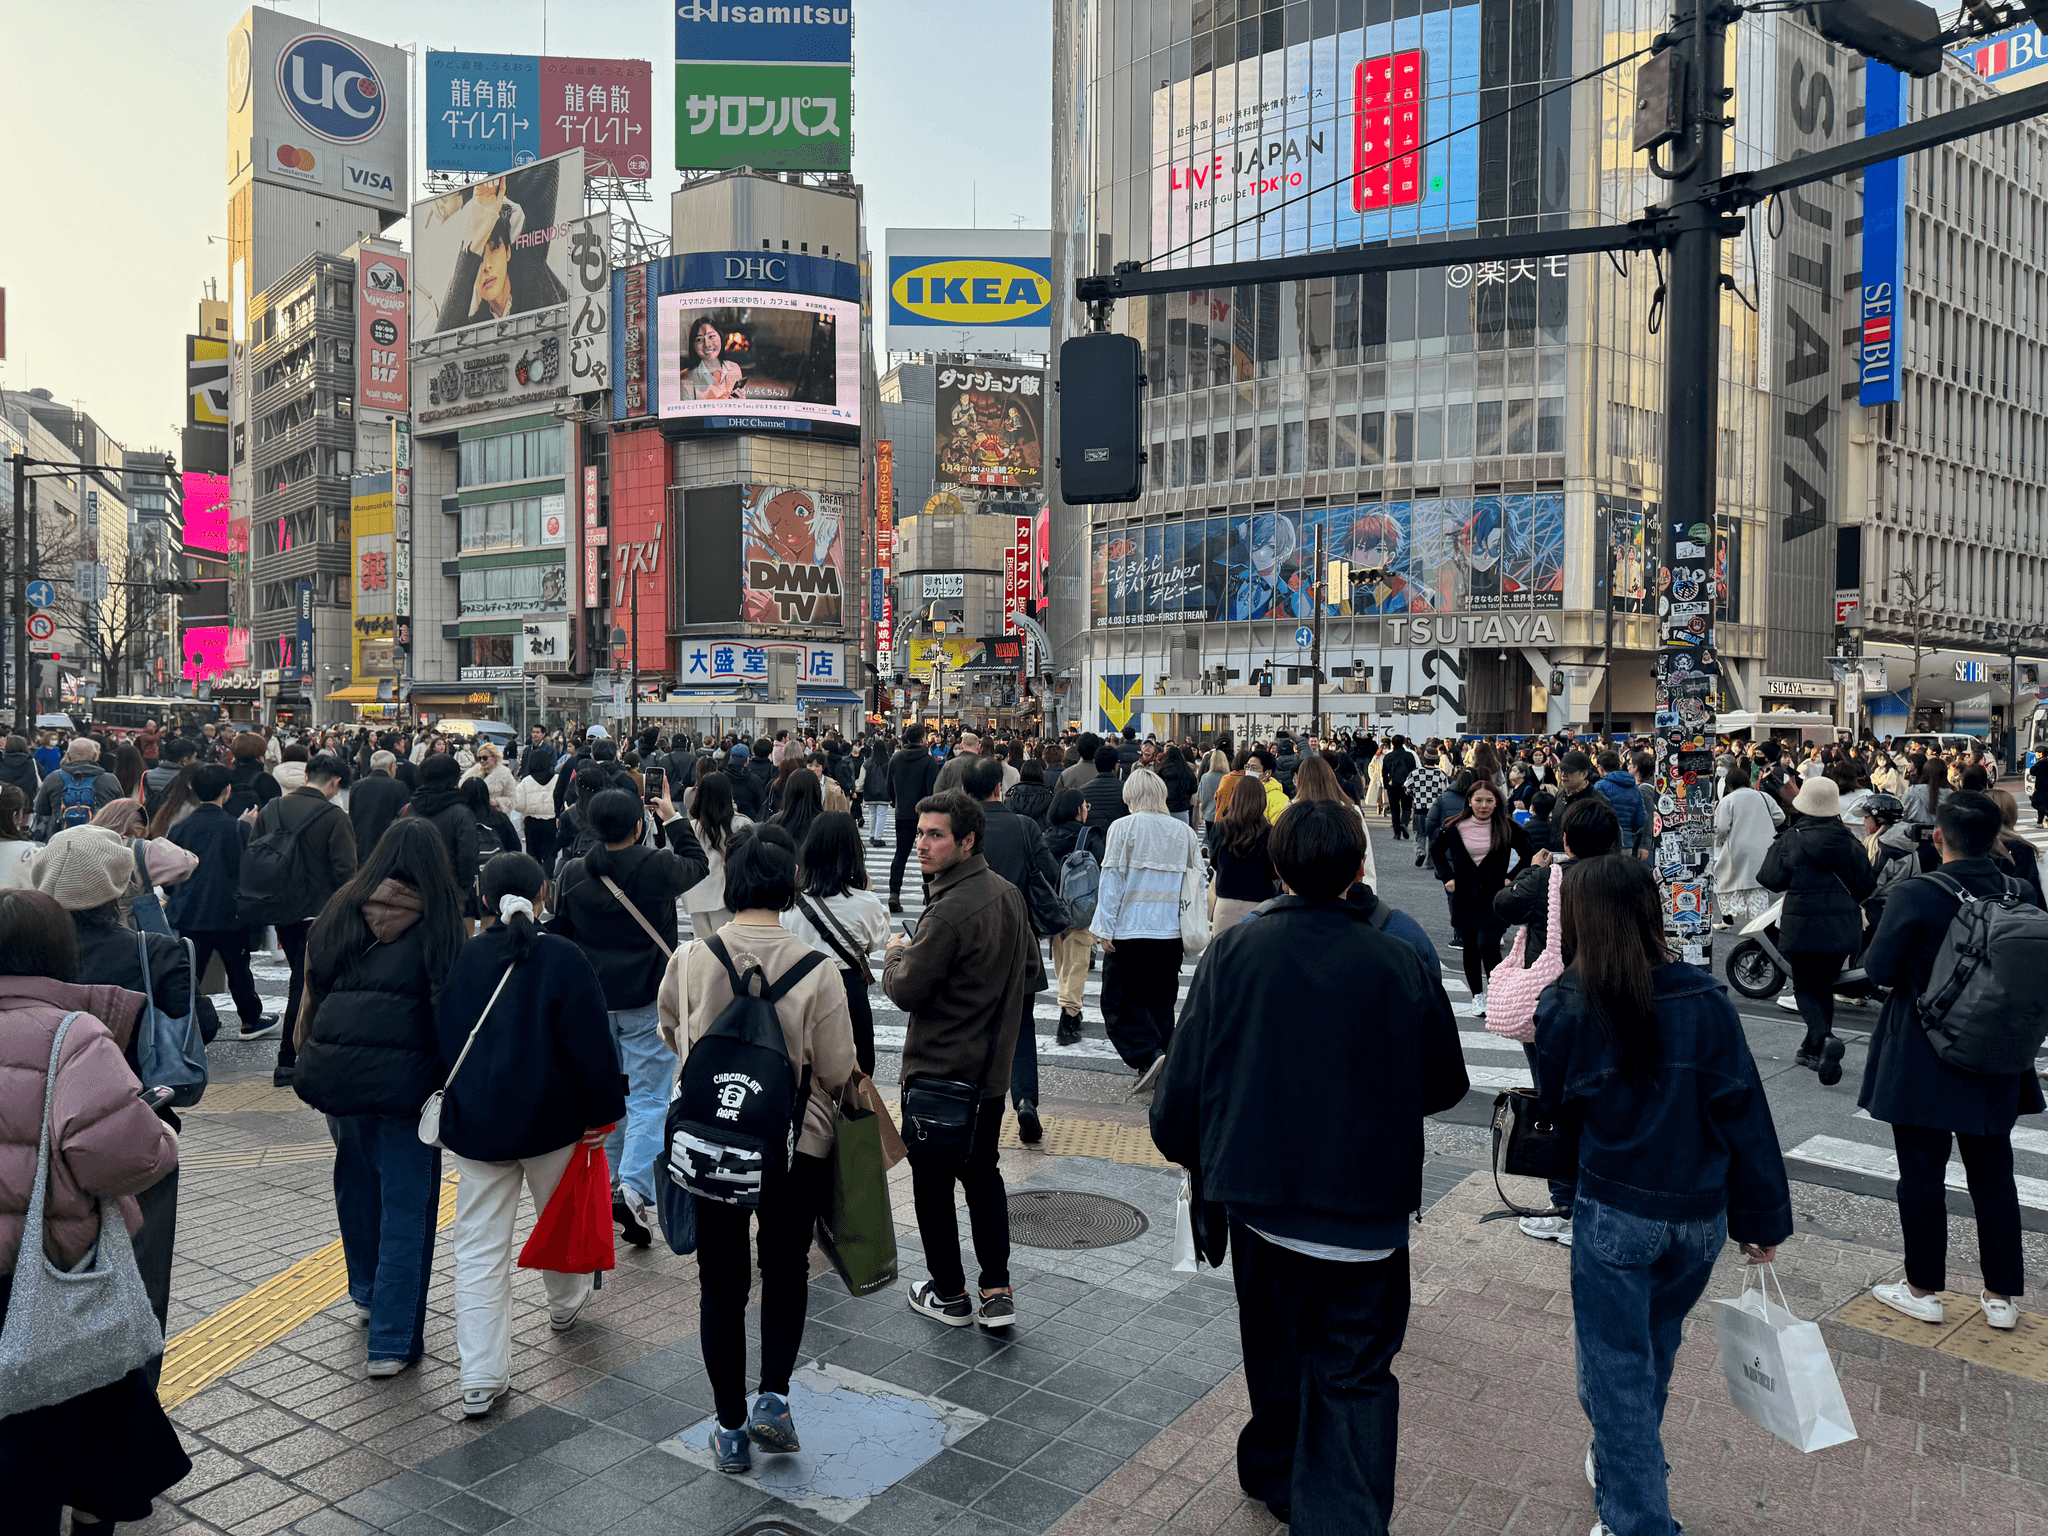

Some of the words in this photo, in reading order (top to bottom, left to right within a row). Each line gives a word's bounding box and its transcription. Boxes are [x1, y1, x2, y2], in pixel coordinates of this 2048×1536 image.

[678, 0, 848, 25] Hisamitsu
[434, 59, 533, 72] のど、直接、うるおう
[451, 78, 517, 109] 龍角散
[565, 83, 630, 114] 龍角散
[441, 110, 530, 140] ダイレクト
[686, 94, 840, 137] サロンパス
[555, 115, 643, 145] ダイレクト
[278, 166, 315, 180] mastercard
[629, 160, 649, 172] 生薬
[1171, 156, 1223, 190] LIVE
[1232, 132, 1325, 175] JAPAN
[346, 166, 394, 193] VISA
[1185, 197, 1219, 213] PRFECT
[1220, 189, 1248, 203] GUDE
[1250, 172, 1302, 197] TOKYO
[724, 257, 786, 282] DHC
[362, 289, 405, 311] VANGUARD
[571, 220, 608, 387] もんじゃ
[907, 277, 1043, 305] IKEA
[374, 324, 395, 334] 10:00
[1862, 282, 1892, 386] SEIBU
[371, 349, 397, 366] B1F
[371, 365, 399, 383] B2F
[938, 368, 1041, 396] ダンジョン飯
[728, 418, 750, 428] DHC
[750, 418, 786, 429] Channel
[235, 434, 246, 453] 7F
[879, 443, 891, 524] クスリのことなら
[820, 494, 842, 506] GREAT
[361, 551, 387, 591] 薬
[1016, 525, 1030, 591] カラオケ
[1101, 554, 1163, 585] にじさんじ
[750, 561, 840, 595] DMM
[924, 587, 963, 596] クリニック
[934, 576, 963, 587] れいわ
[1113, 564, 1201, 599] 新人VTuber
[461, 601, 539, 614] ジャスミンレディースクリニック
[775, 593, 817, 622] TV
[873, 570, 883, 620] 大盛堂商事ビル
[1150, 583, 1203, 606] デビュー
[1465, 594, 1559, 604] 好きなもので、世界をつくれ。
[1387, 614, 1556, 645] TSUTAYA
[689, 647, 834, 676] 大盛堂店
[1955, 660, 1989, 683] SEIBU
[1768, 682, 1802, 694] TSUTAYA
[713, 1072, 765, 1096] CHOCOOLATE
[716, 1108, 740, 1122] AAPE
